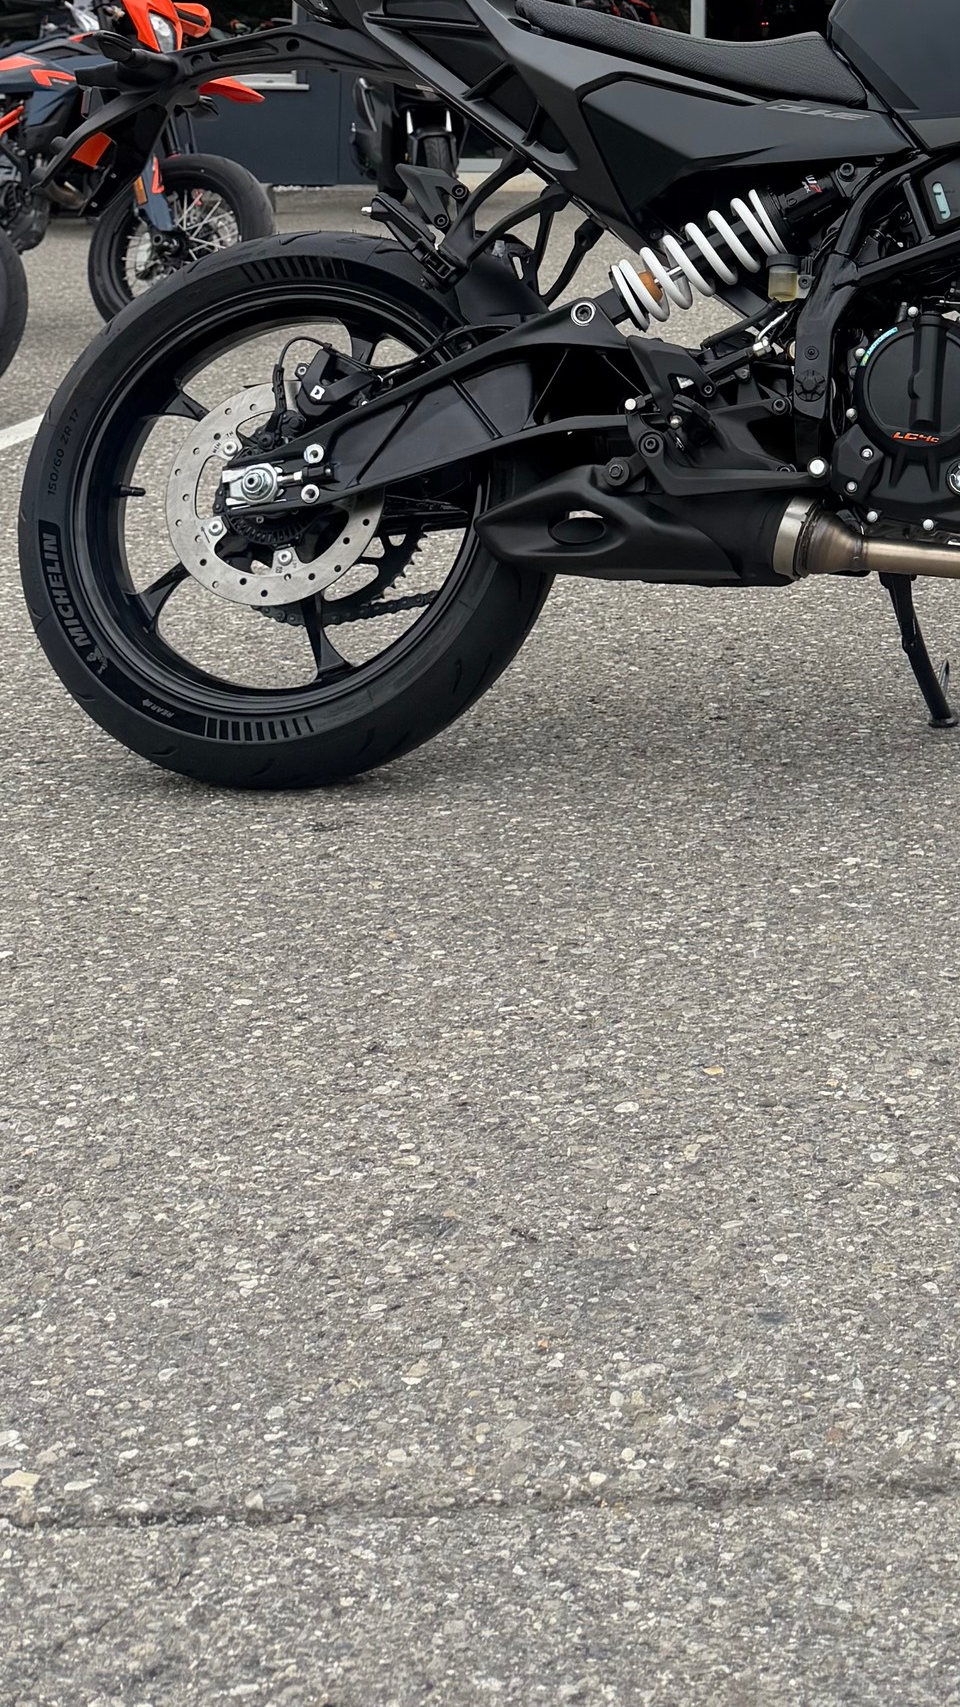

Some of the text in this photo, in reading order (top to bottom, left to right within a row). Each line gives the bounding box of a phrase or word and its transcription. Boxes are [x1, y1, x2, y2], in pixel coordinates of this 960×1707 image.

[47, 408, 80, 496] 150/60 ZR 17
[41, 532, 91, 648] MICHELIN
